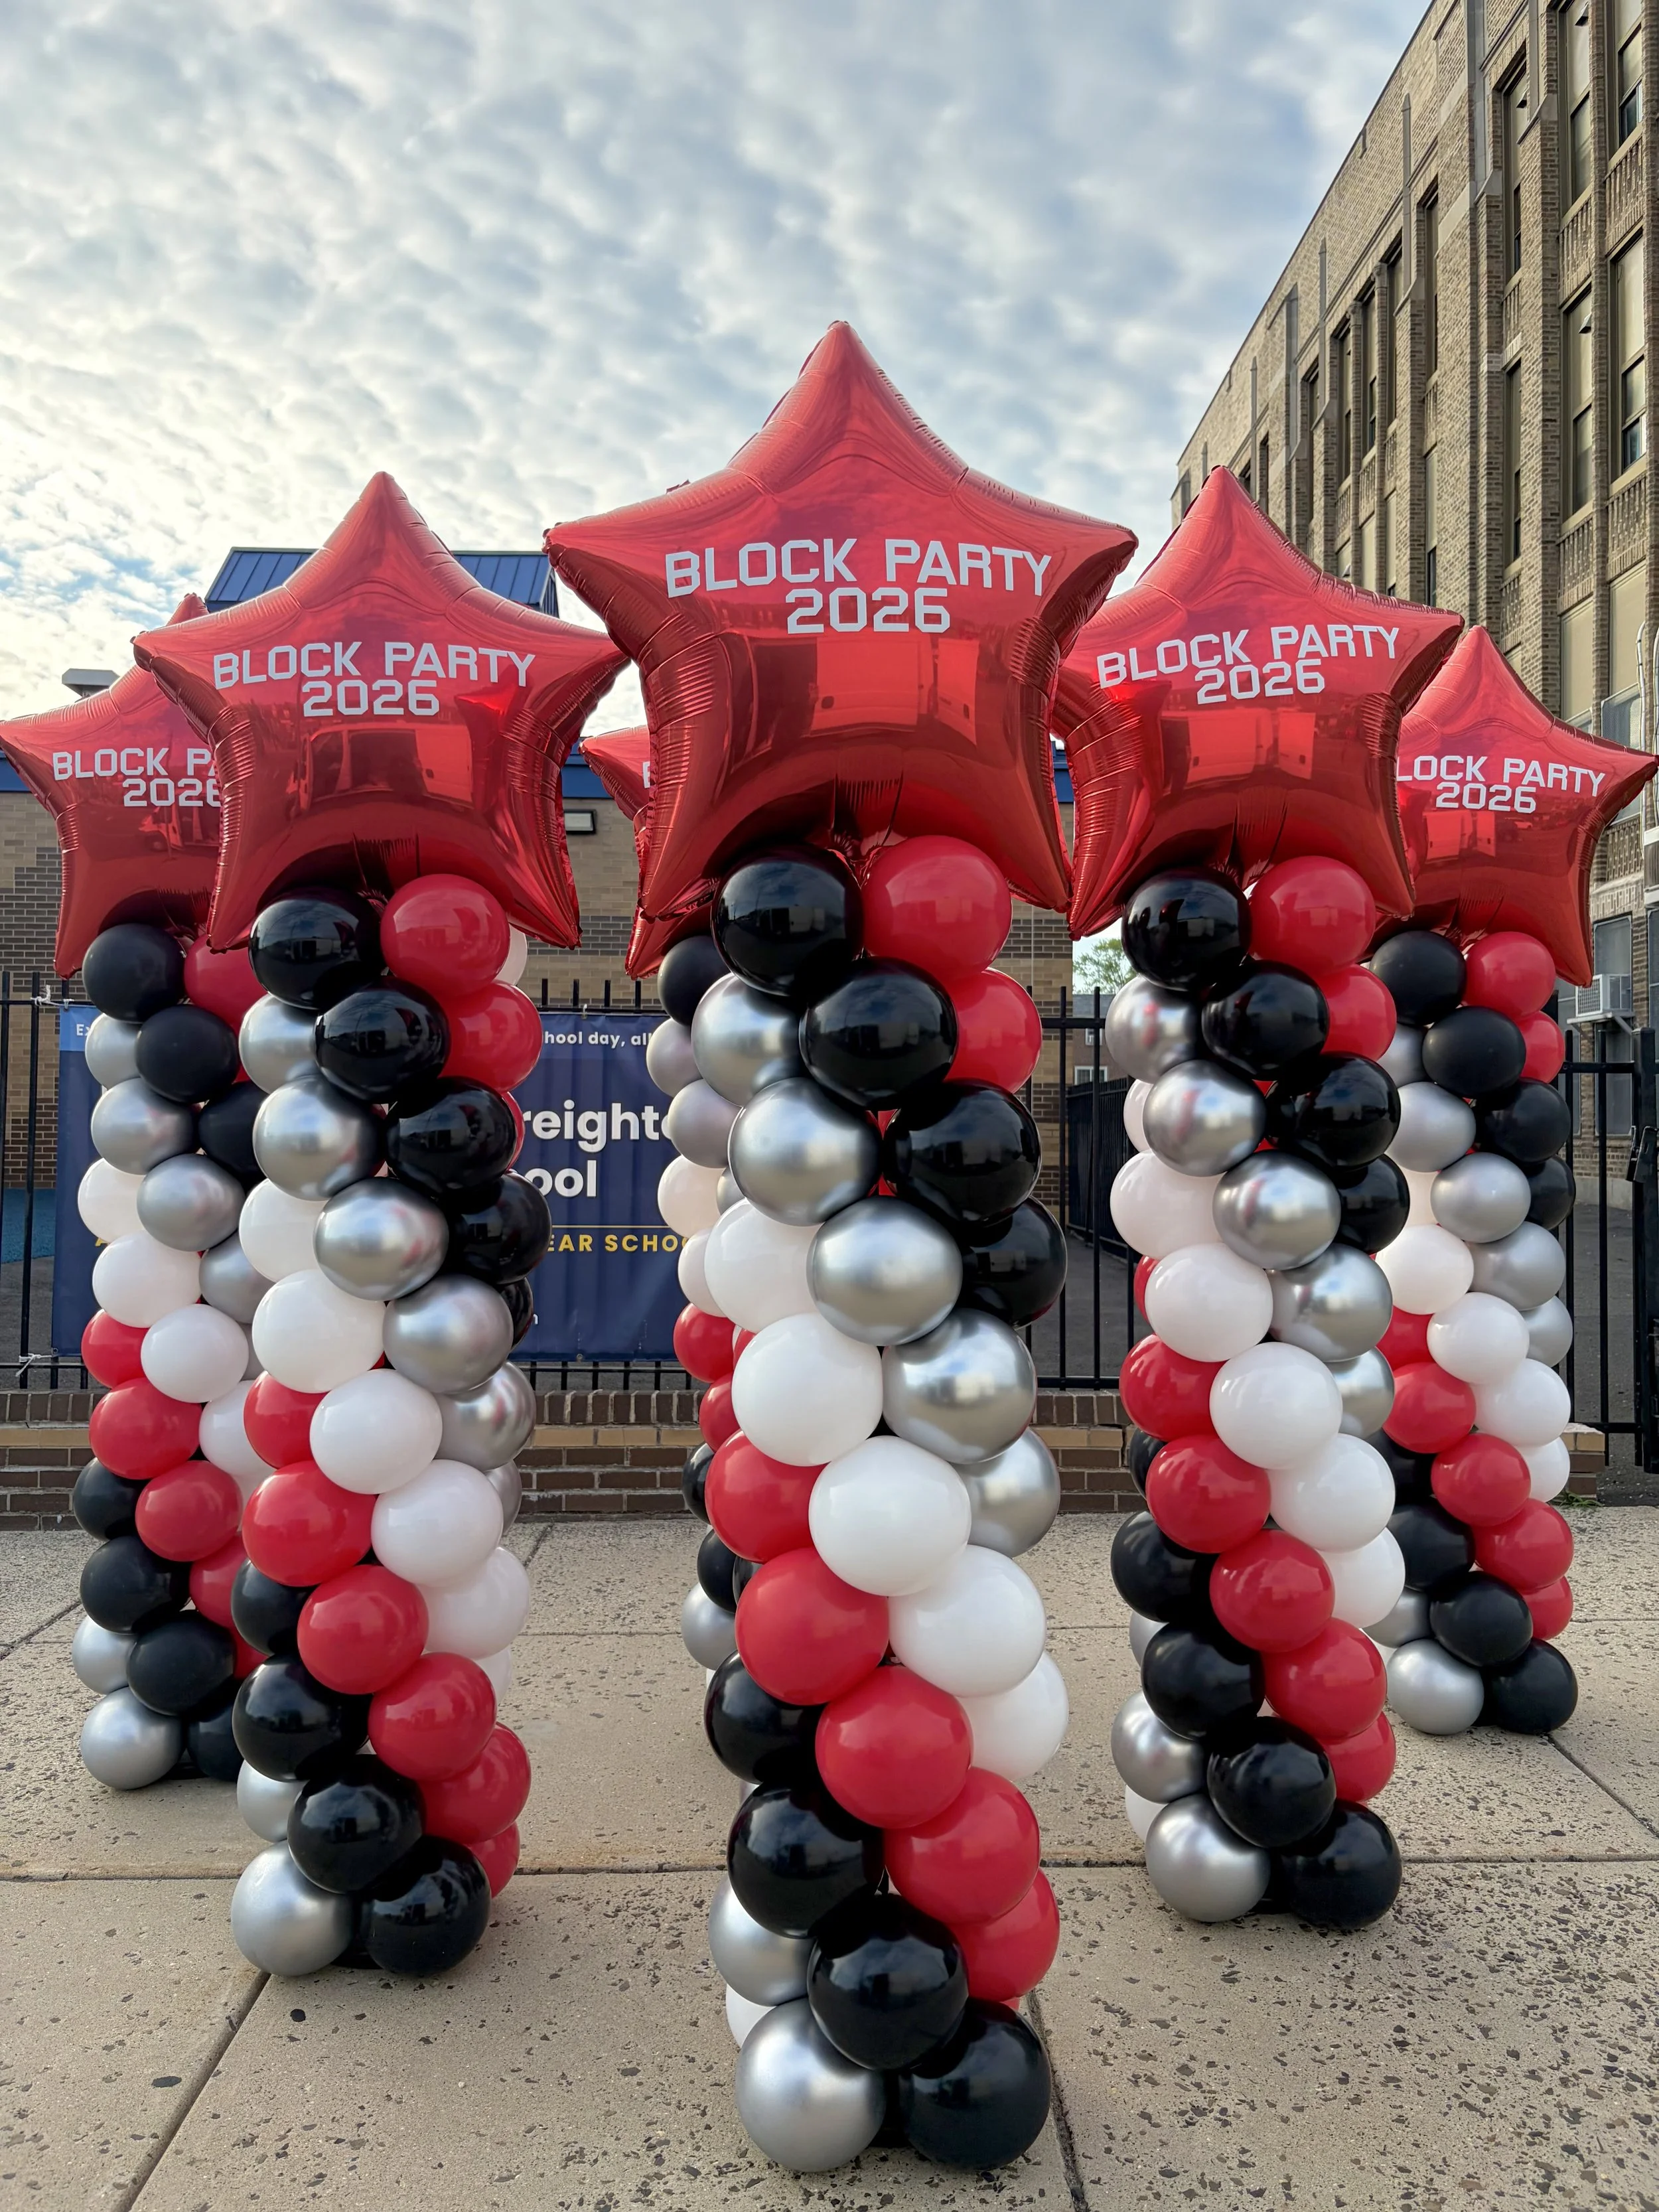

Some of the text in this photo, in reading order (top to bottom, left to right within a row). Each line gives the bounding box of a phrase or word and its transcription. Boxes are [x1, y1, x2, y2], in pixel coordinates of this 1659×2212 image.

[666, 539, 1052, 597] BLOCK PARTY
[786, 587, 950, 634] 2026
[214, 642, 536, 690] BLOCK PARTY
[1097, 625, 1399, 689] BLOCK PARTY
[303, 680, 439, 717] 2026
[1194, 659, 1325, 705] 2026
[52, 747, 169, 781] BLOCK
[1503, 757, 1606, 797] PARTY
[1435, 782, 1537, 814] 2026
[588, 1031, 625, 1049] day,
[605, 1234, 687, 1252] SCHO
